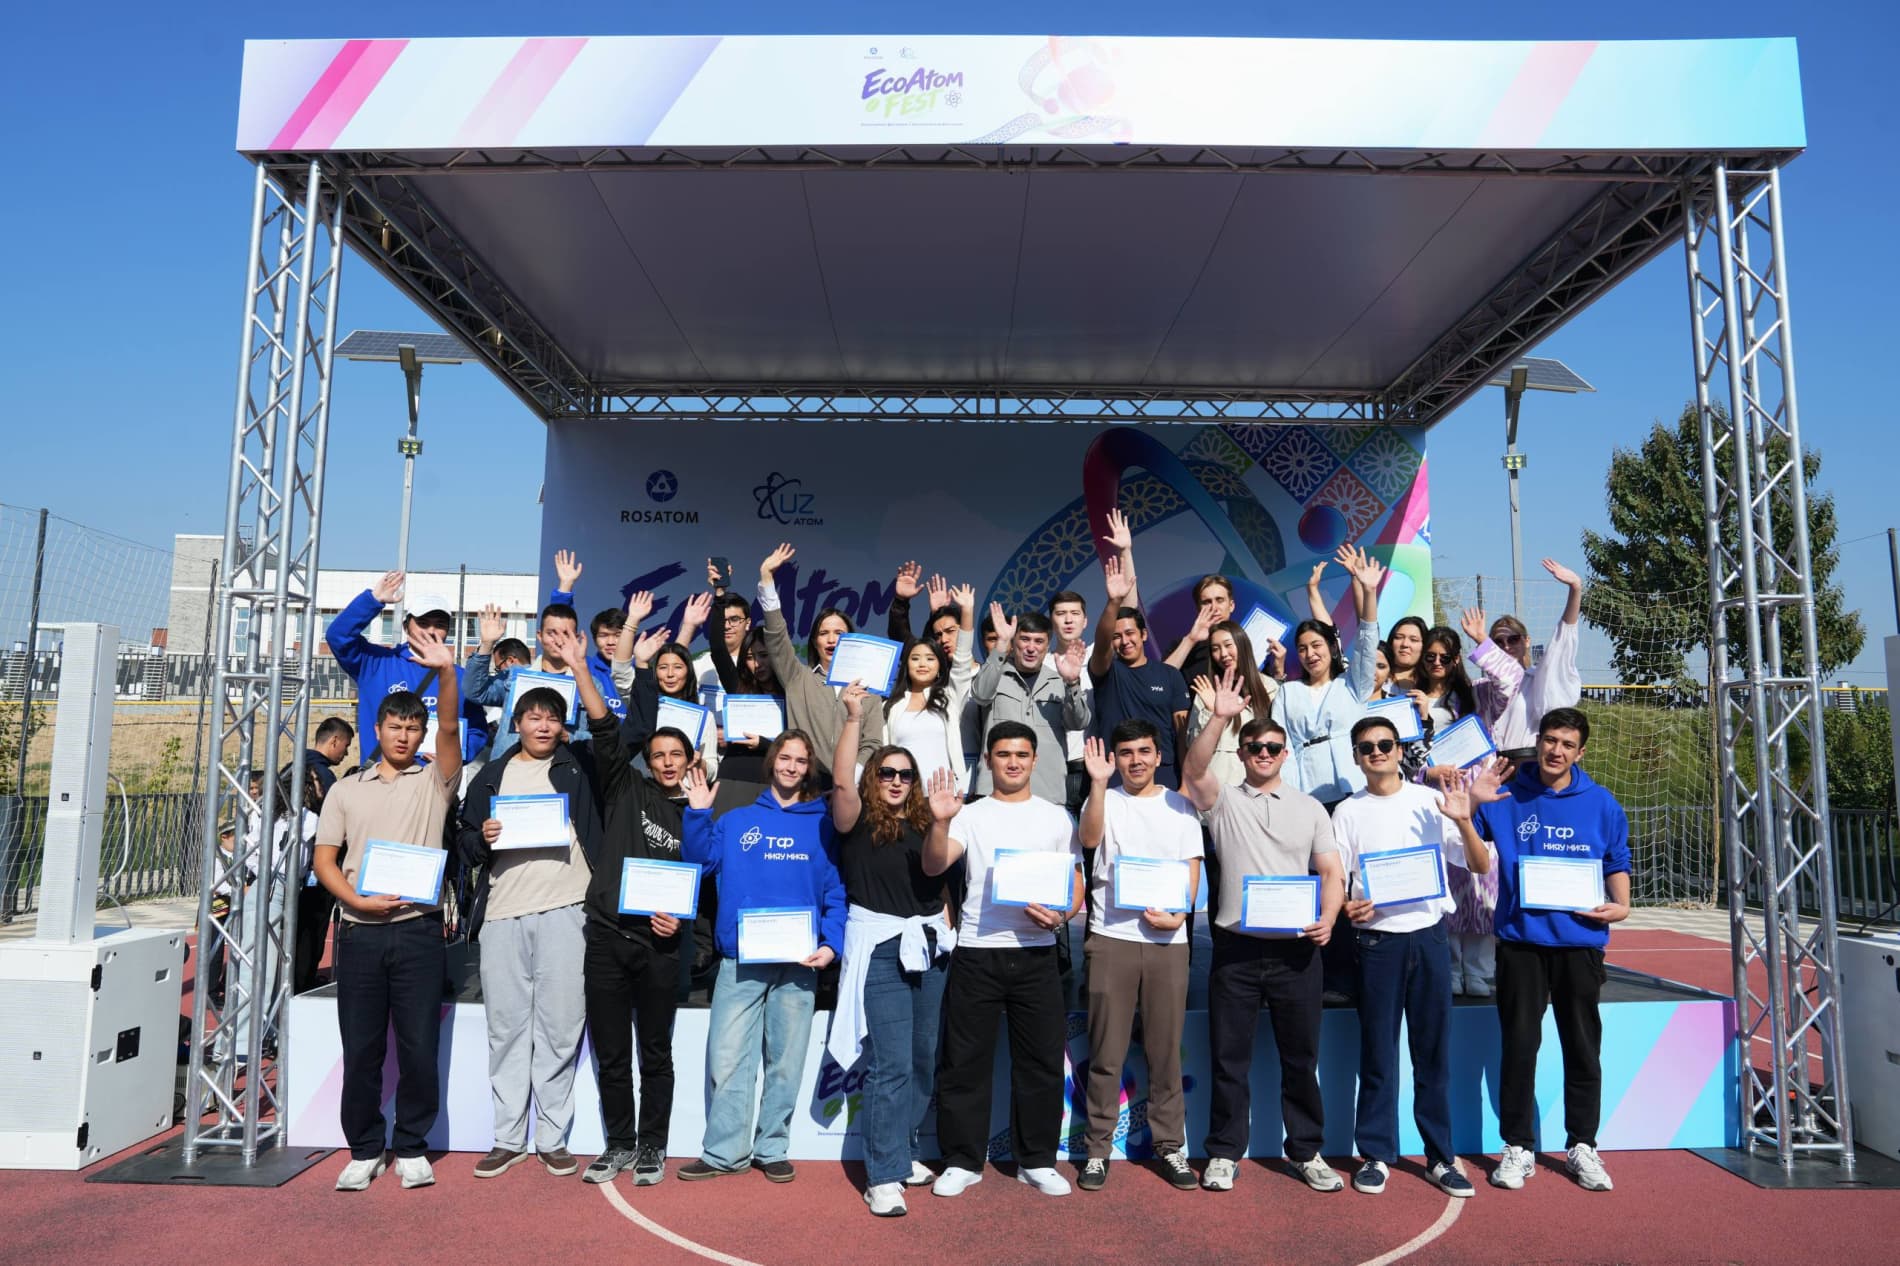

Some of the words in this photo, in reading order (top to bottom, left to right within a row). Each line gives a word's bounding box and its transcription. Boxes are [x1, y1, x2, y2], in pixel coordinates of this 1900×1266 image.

[884, 88, 945, 118] FEST
[780, 494, 815, 514] UZ
[620, 510, 699, 524] ROSATOM
[793, 518, 823, 527] ATOM
[620, 561, 898, 643] EAtom
